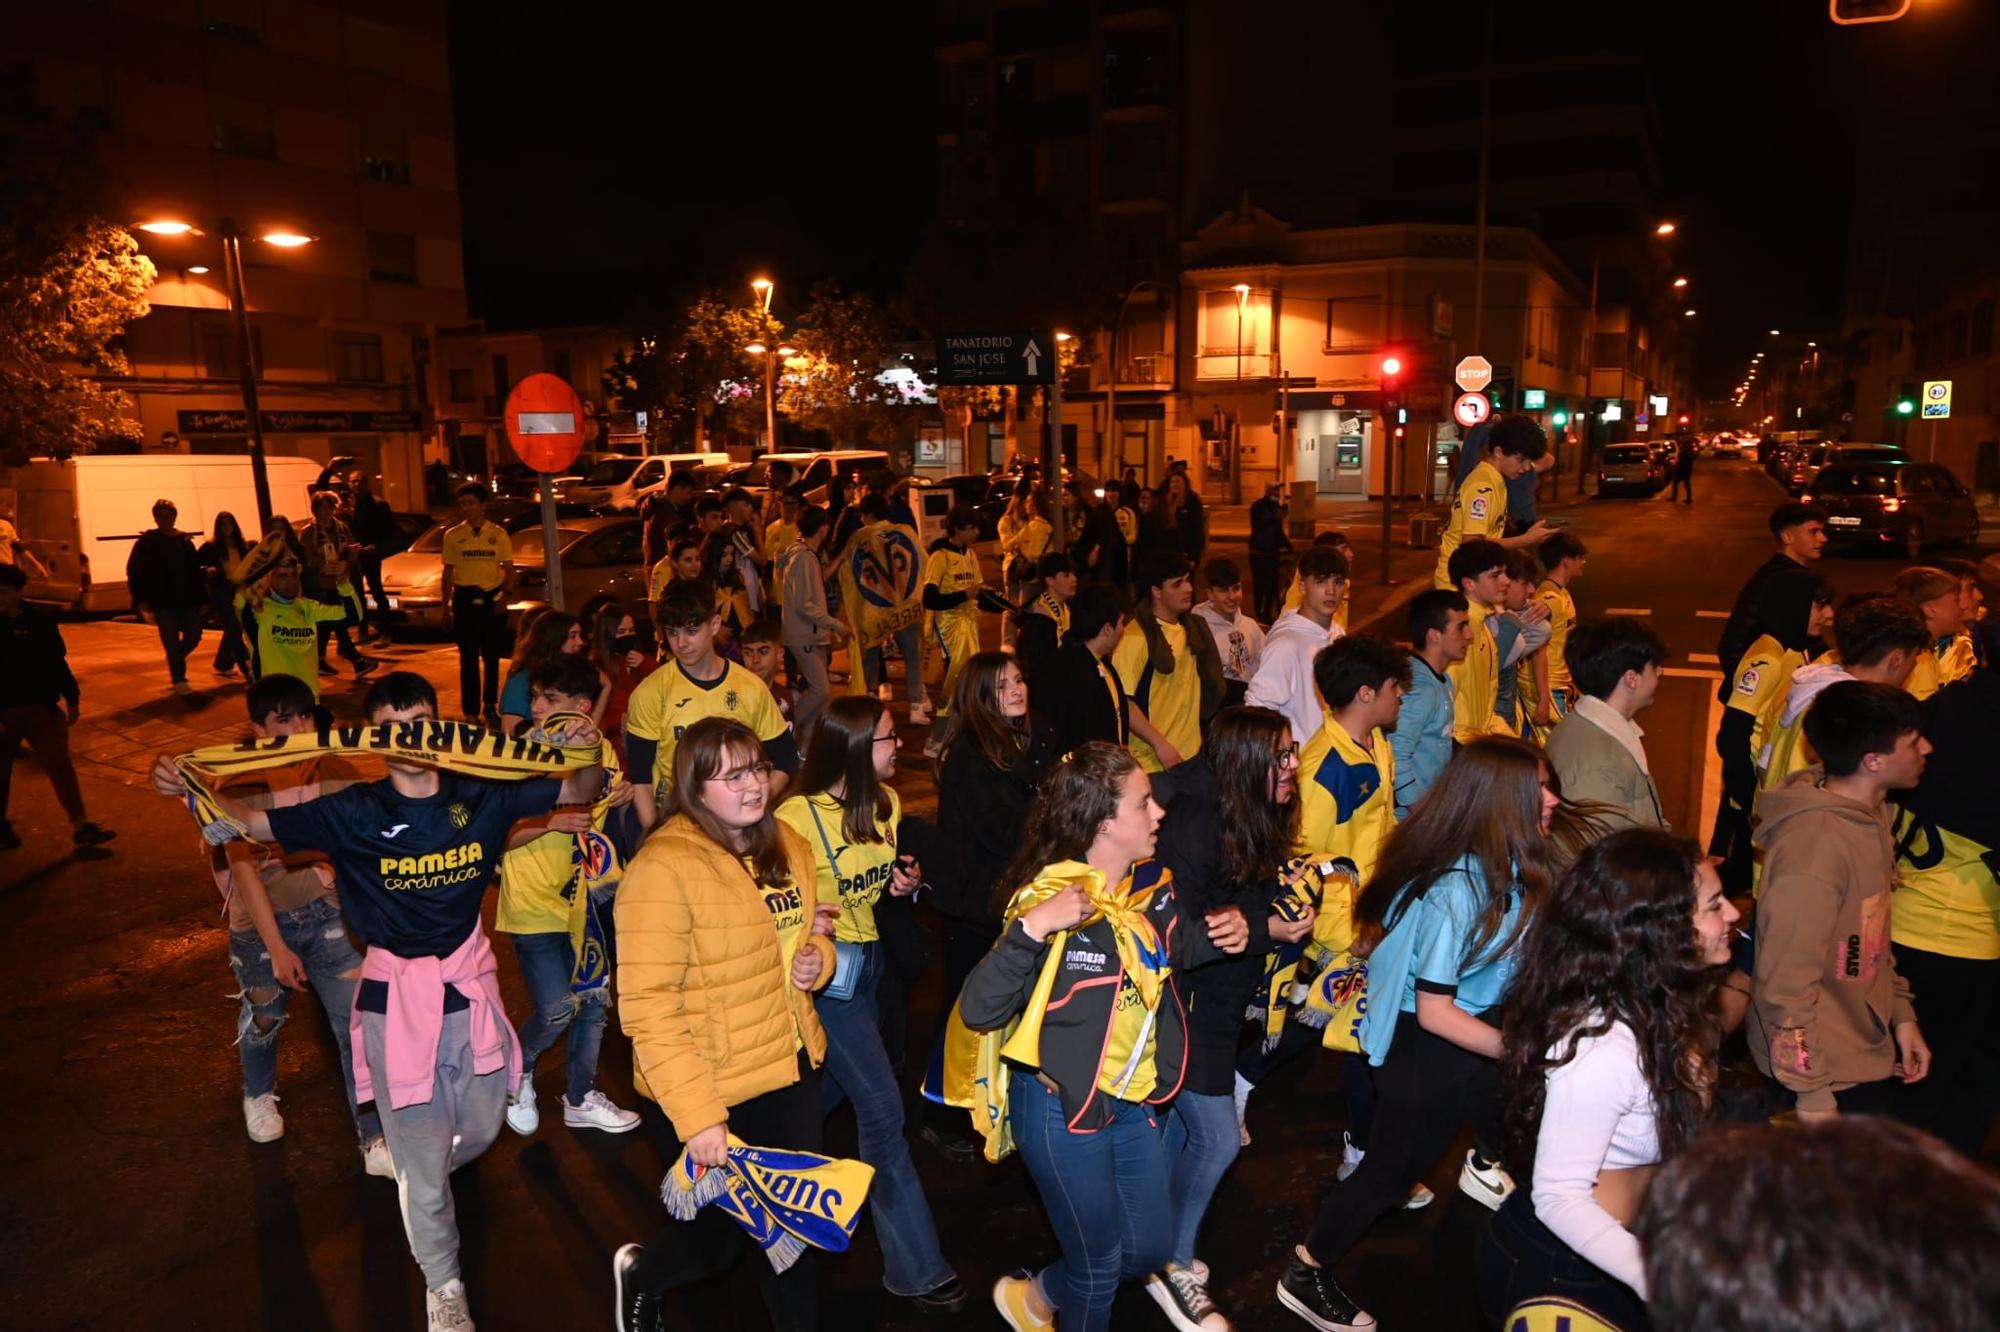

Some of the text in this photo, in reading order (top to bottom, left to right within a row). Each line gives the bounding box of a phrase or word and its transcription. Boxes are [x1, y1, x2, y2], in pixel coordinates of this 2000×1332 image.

[946, 337, 1013, 349] TANATORIO
[953, 354, 976, 365] SAN
[1460, 370, 1489, 379] STOP
[380, 842, 483, 875] PAMESA
[384, 867, 481, 891] cerámica
[1066, 950, 1106, 965] PAMESA
[1846, 933, 1860, 977] STWD
